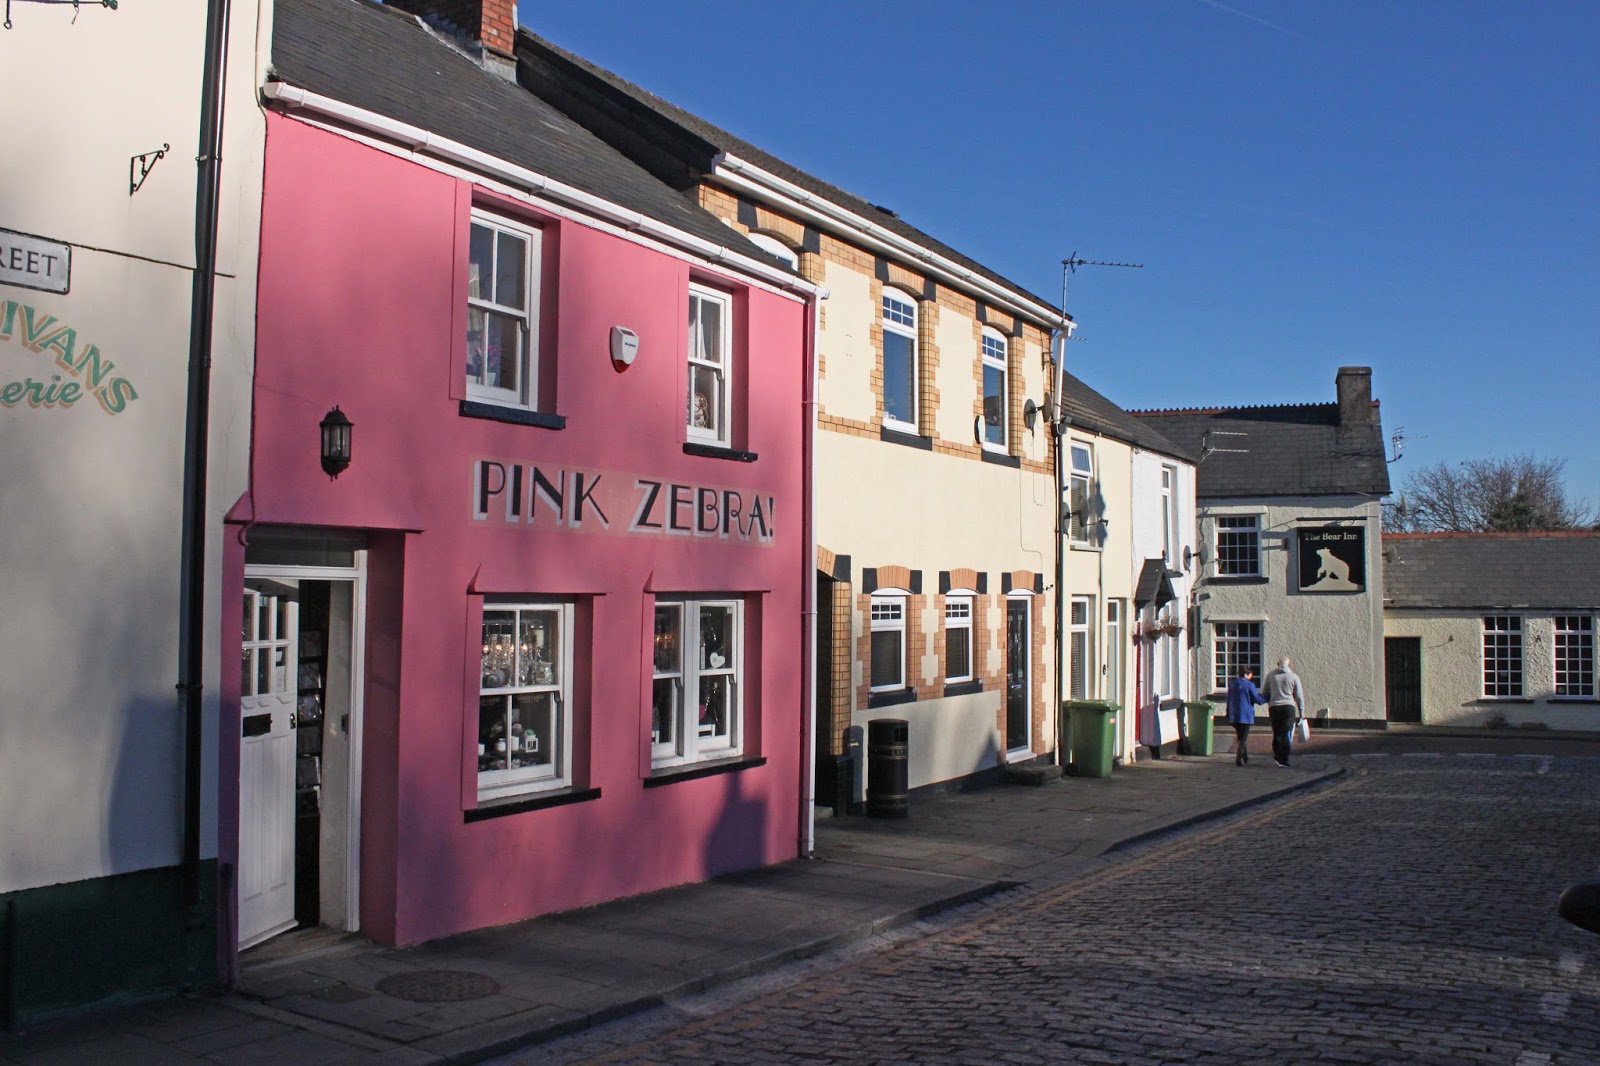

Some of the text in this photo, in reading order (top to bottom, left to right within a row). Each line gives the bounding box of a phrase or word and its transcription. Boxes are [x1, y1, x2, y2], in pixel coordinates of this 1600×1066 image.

[473, 460, 775, 543] PINK ZEBRA!
[1304, 531, 1358, 541] The Bear Inn
